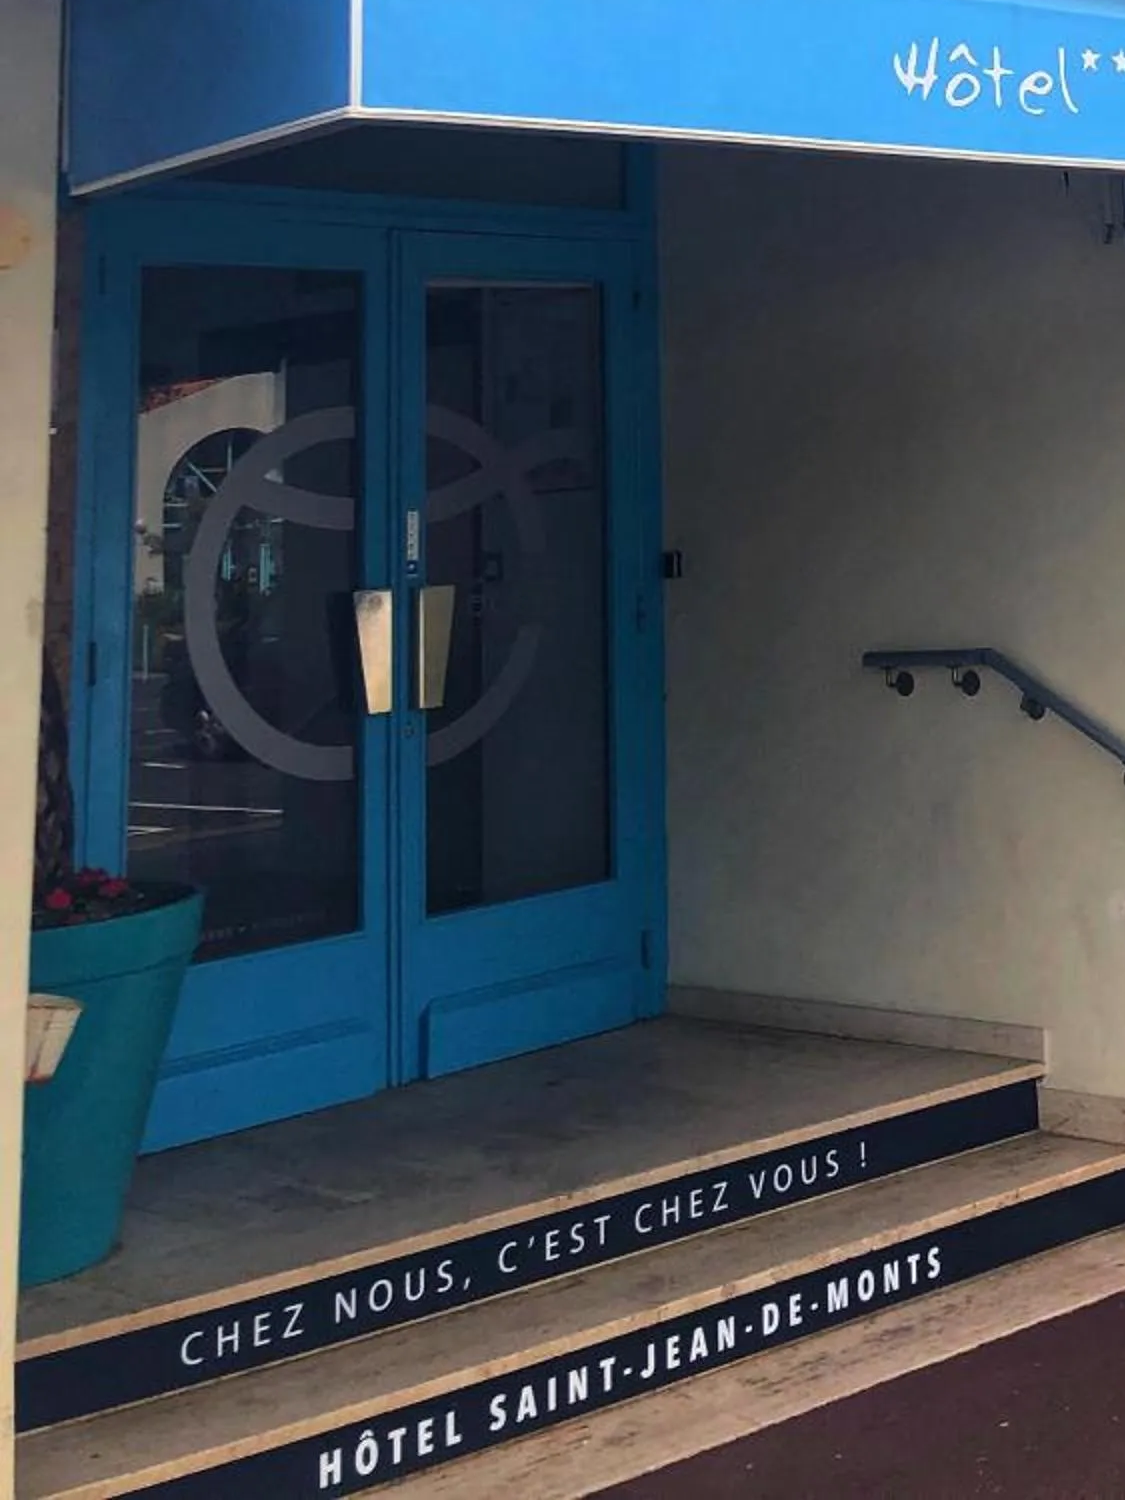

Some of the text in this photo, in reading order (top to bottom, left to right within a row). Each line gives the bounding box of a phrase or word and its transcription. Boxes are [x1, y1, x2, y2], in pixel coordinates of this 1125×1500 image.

[180, 1303, 304, 1366] CHEZ
[334, 1259, 471, 1324] NOUS,
[633, 1181, 729, 1234] CHEZ
[748, 1149, 840, 1200] VOUS
[319, 1246, 942, 1487] HÔTEL SAINT-JEAN-DE-MONTS
